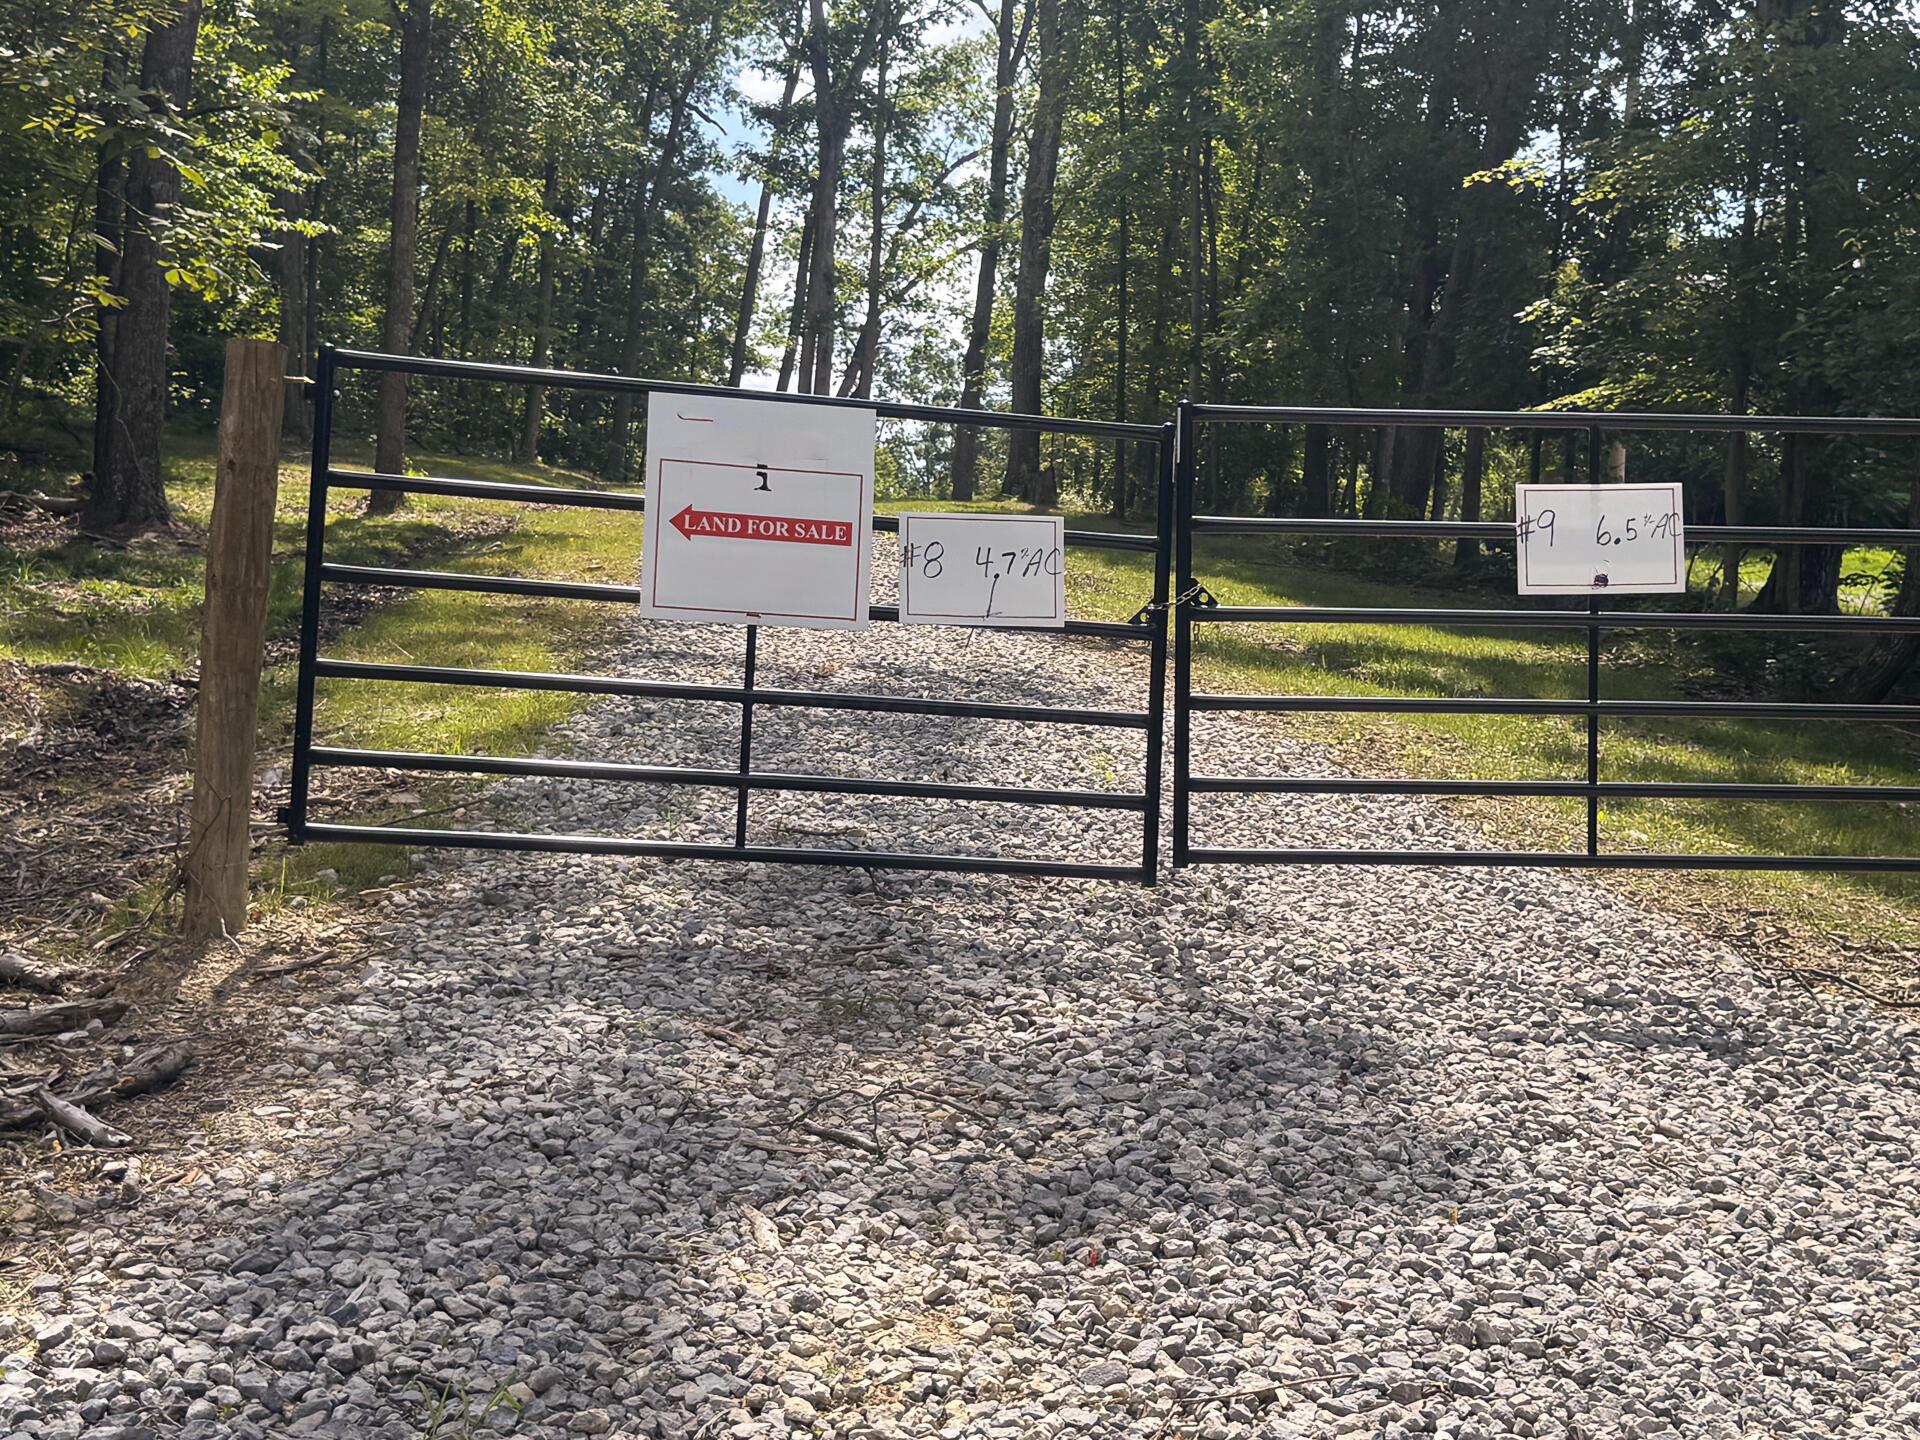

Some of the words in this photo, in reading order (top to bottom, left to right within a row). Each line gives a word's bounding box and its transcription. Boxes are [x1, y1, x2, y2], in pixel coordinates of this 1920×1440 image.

[684, 514, 742, 534] LAND
[747, 519, 789, 537] FOR
[794, 522, 847, 541] SALE
[1517, 509, 1556, 547] #9
[900, 541, 944, 578] #8
